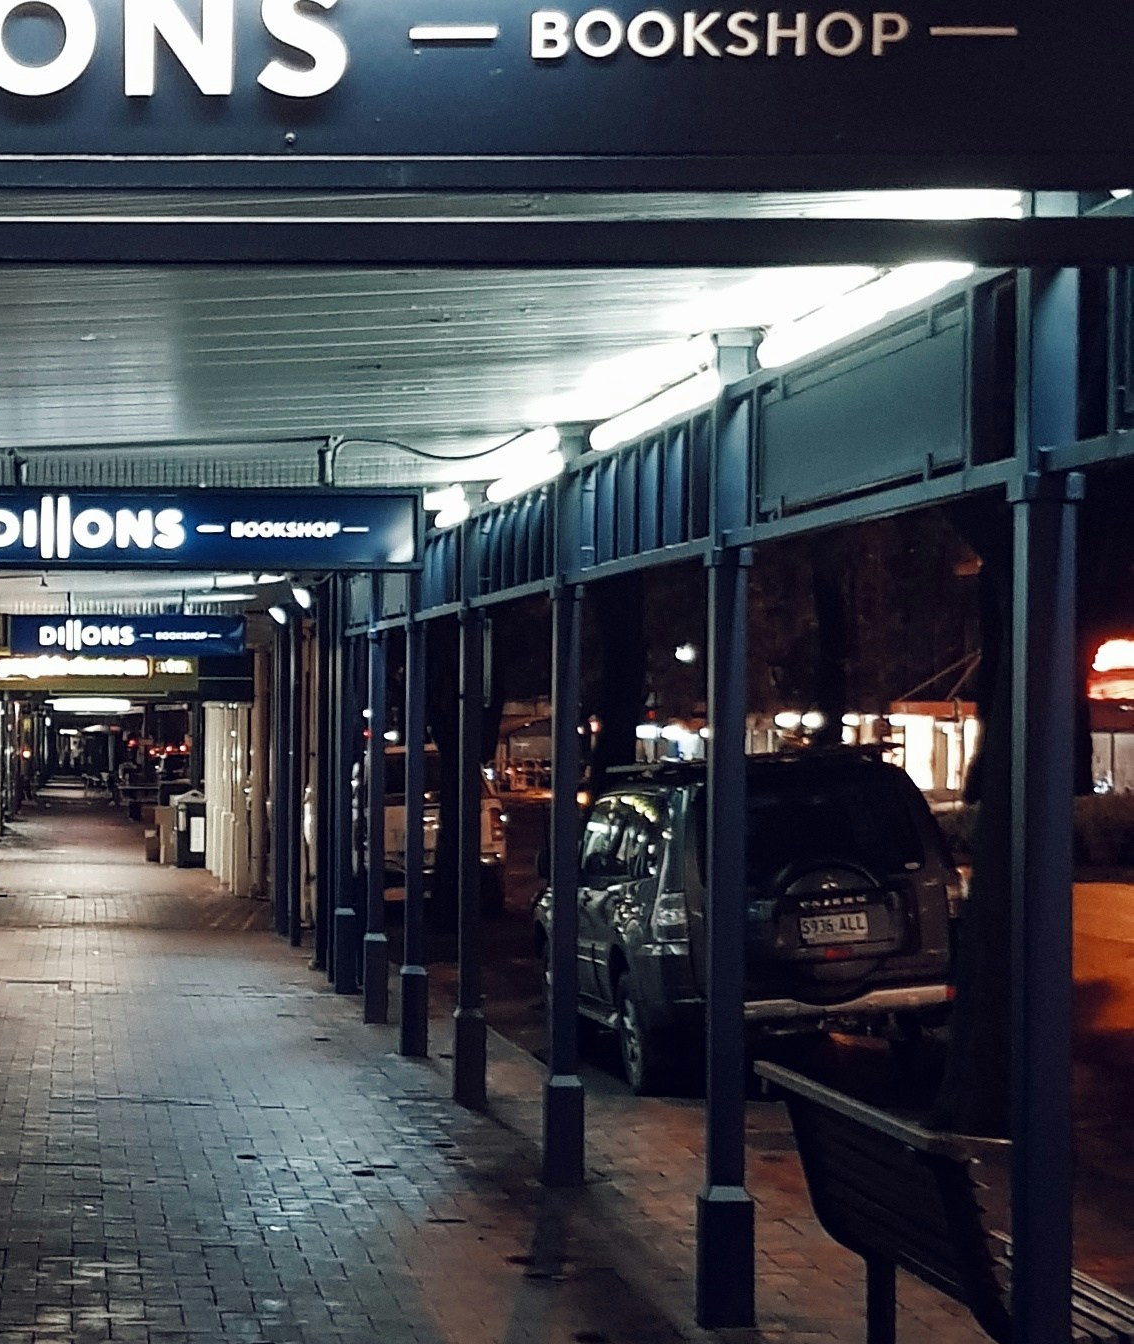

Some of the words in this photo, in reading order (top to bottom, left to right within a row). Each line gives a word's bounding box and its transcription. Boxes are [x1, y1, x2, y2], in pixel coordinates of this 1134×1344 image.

[530, 9, 909, 58] BOOKSHOP
[230, 521, 341, 538] BOOKSHOP
[154, 631, 208, 641] BOOKSHOP
